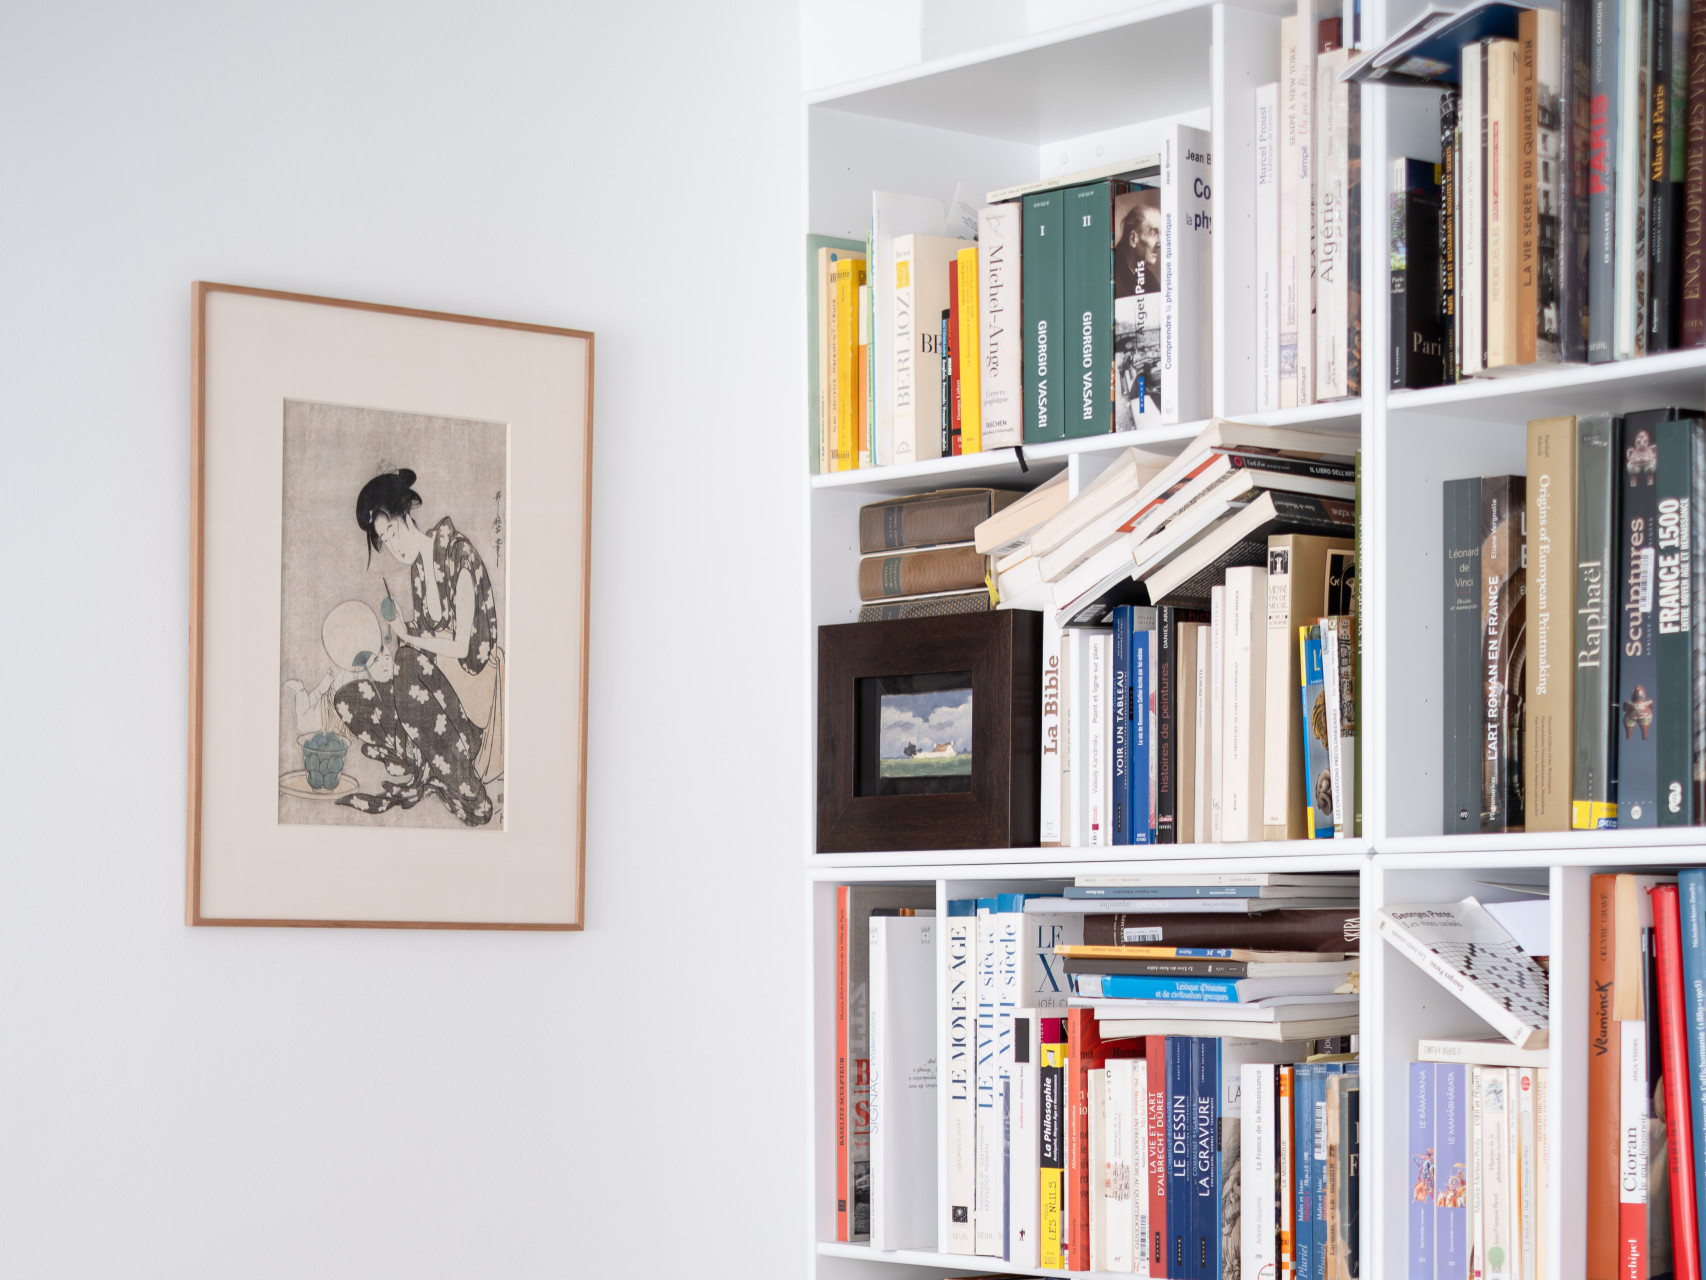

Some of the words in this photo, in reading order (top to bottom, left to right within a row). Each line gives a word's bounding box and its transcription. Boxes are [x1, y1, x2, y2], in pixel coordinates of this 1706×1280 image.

[1524, 40, 1533, 81] LATIN
[1259, 106, 1267, 142] Proust
[1523, 87, 1533, 154] QUARTIER
[1652, 84, 1664, 123] Paris
[1589, 94, 1608, 194] PARIS
[1652, 126, 1664, 142] de
[1259, 146, 1267, 184] Marcel
[1524, 161, 1532, 178] DU
[1651, 146, 1664, 182] Atlas
[1521, 183, 1532, 236] SECRÈTE
[1320, 193, 1338, 283] Algérie
[1523, 239, 1532, 260] VIE
[1136, 260, 1145, 294] Paris
[1523, 266, 1532, 286] LA
[1136, 298, 1146, 335] Atget
[1038, 320, 1048, 376] GIORGIO
[1082, 312, 1092, 368] GIORGIO
[1038, 380, 1047, 427] VASARI
[1083, 372, 1092, 420] VASARI
[1537, 475, 1551, 528] Origins
[1537, 529, 1549, 543] of
[1659, 499, 1679, 549] 1500
[1449, 547, 1479, 559] Léonard
[1459, 563, 1469, 573] de
[1455, 578, 1474, 588] Vinci
[1537, 547, 1551, 609] European
[1659, 554, 1680, 633] FRANCE
[1488, 576, 1498, 635] FRANCE
[1578, 560, 1608, 667] Raphaël
[1488, 641, 1498, 659] EN
[1536, 613, 1550, 695] Printmaking
[1044, 655, 1059, 717] Bible
[1160, 663, 1170, 718] peintures
[1488, 664, 1498, 717] ROMAN
[1044, 724, 1058, 755] La
[1117, 726, 1124, 743] UN
[1160, 724, 1168, 738] de
[1488, 723, 1498, 760] L'ART
[1160, 743, 1169, 792] histoires
[1392, 910, 1427, 921] Georges
[947, 926, 967, 974] ÂGE
[951, 977, 967, 1061] MOYEN
[1593, 980, 1613, 1056] Vlaminck
[951, 1070, 967, 1101] LE
[1043, 1077, 1053, 1141] Philosophie
[1155, 1092, 1164, 1123] DÜRER
[1173, 1096, 1185, 1154] DESSIN
[1043, 1144, 1051, 1157] La
[1149, 1125, 1156, 1136] ET
[1199, 1096, 1210, 1171] GRAVURE
[1149, 1160, 1156, 1173] LA
[1157, 1126, 1165, 1195] D'ALBRECHT
[1174, 1159, 1185, 1176] LE
[1622, 1127, 1639, 1192] Cioran
[1200, 1176, 1210, 1196] LA
